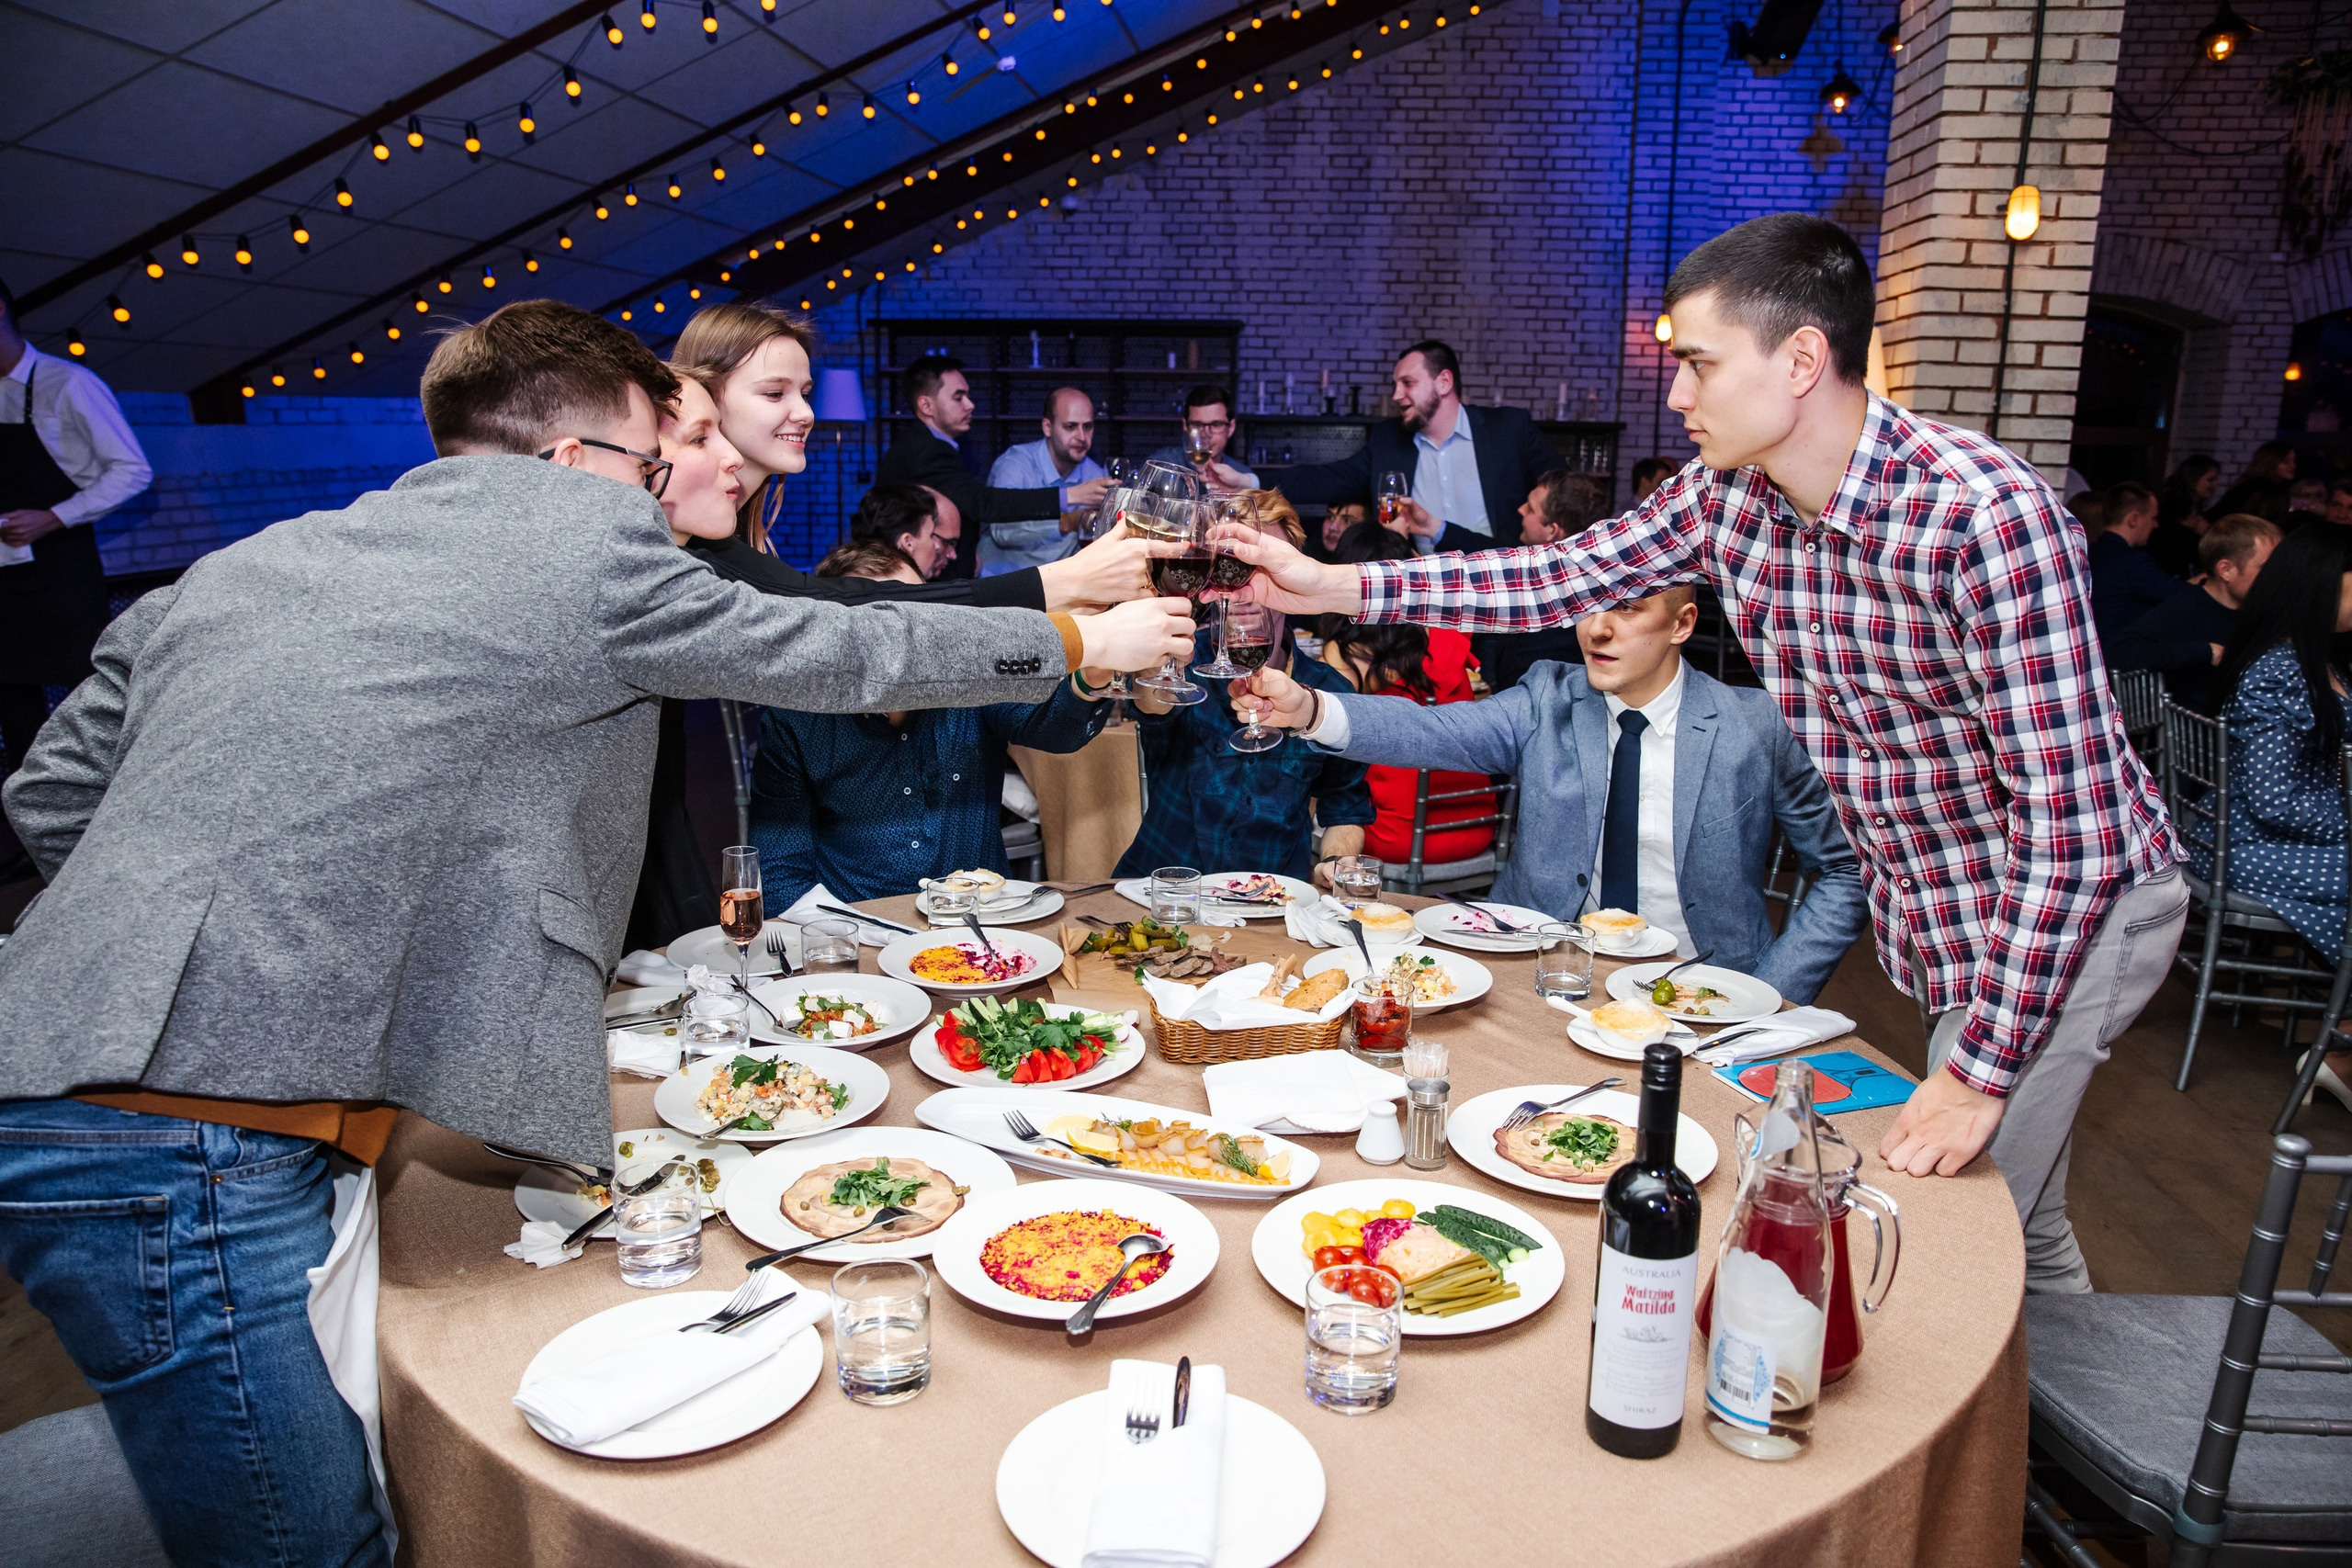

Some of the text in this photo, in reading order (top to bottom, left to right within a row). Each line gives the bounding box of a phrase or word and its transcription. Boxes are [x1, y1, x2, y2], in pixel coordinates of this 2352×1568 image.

[1622, 1266, 1681, 1279] AUSTRALIA
[1625, 1283, 1674, 1300] Waltzing
[1622, 1296, 1676, 1314] Matilda
[1623, 1404, 1657, 1415] SHIRAZ
